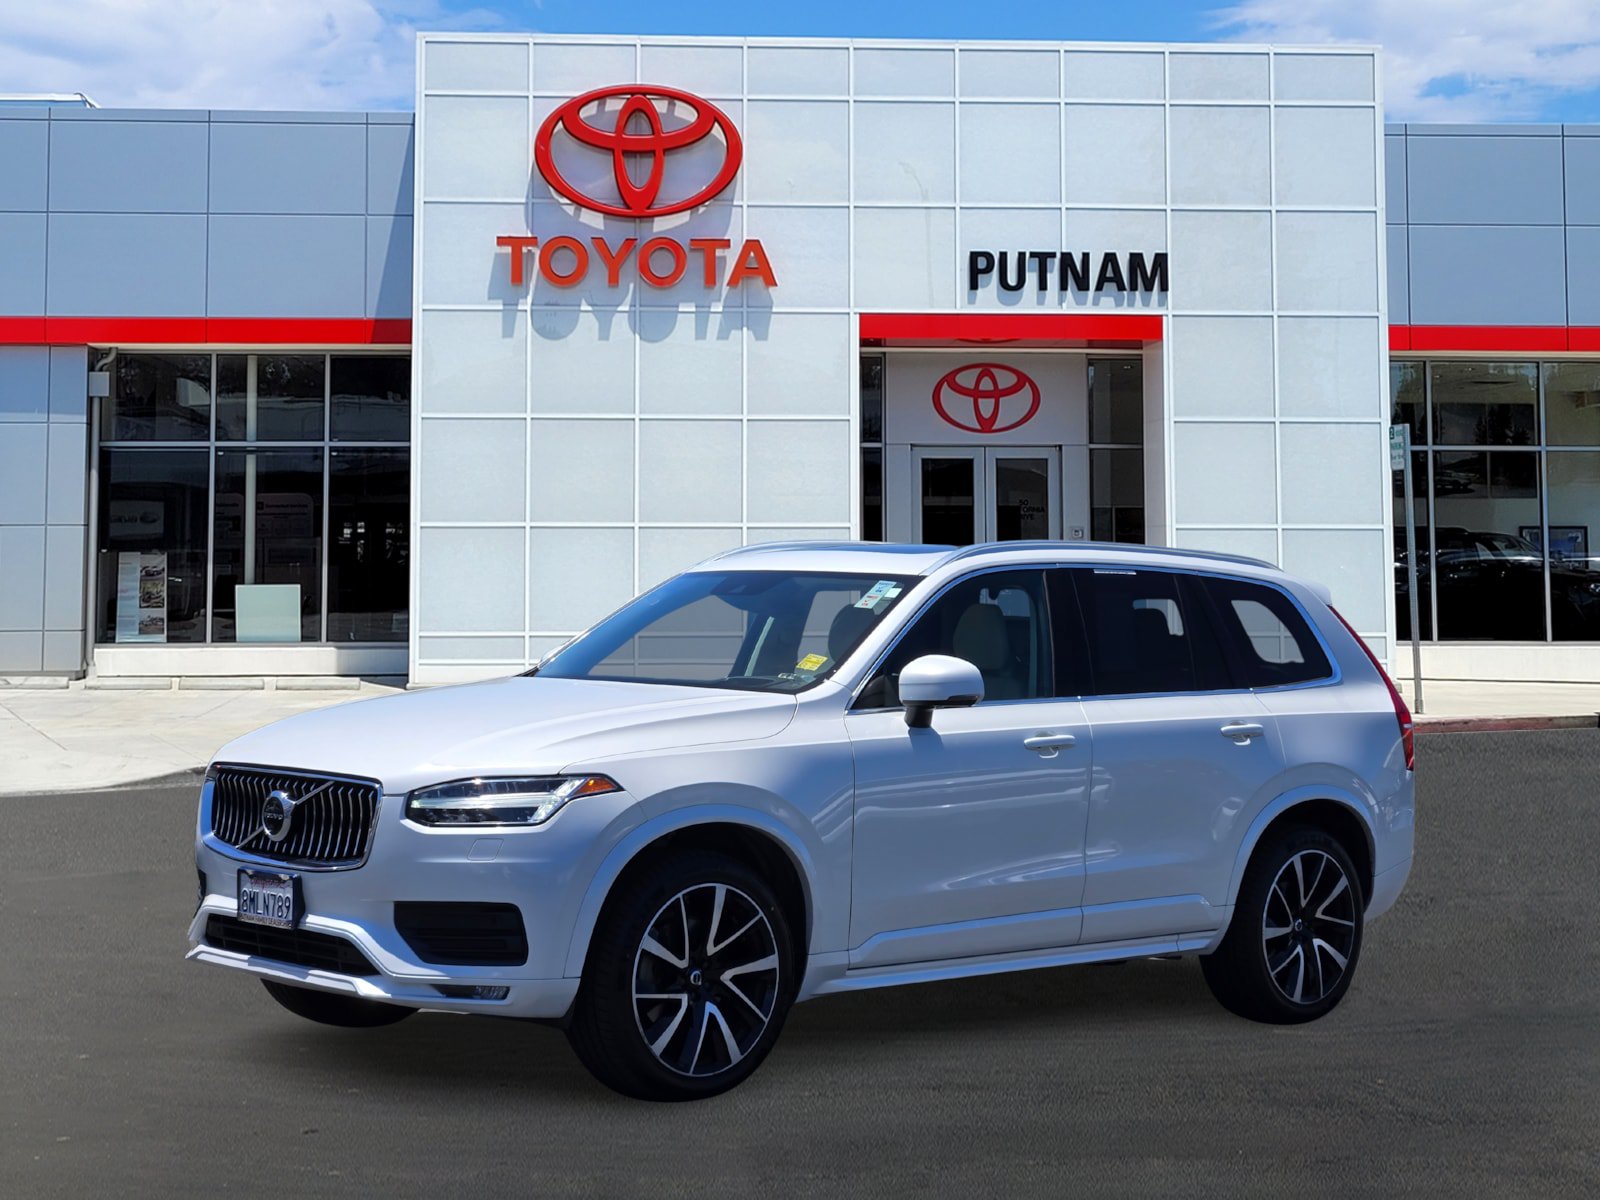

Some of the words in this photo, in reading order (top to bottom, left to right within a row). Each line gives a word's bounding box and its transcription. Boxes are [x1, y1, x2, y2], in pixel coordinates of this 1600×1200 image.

[496, 236, 778, 287] TOYOTA
[969, 251, 1169, 291] PUTNAM
[241, 888, 291, 919] 8MLN789
